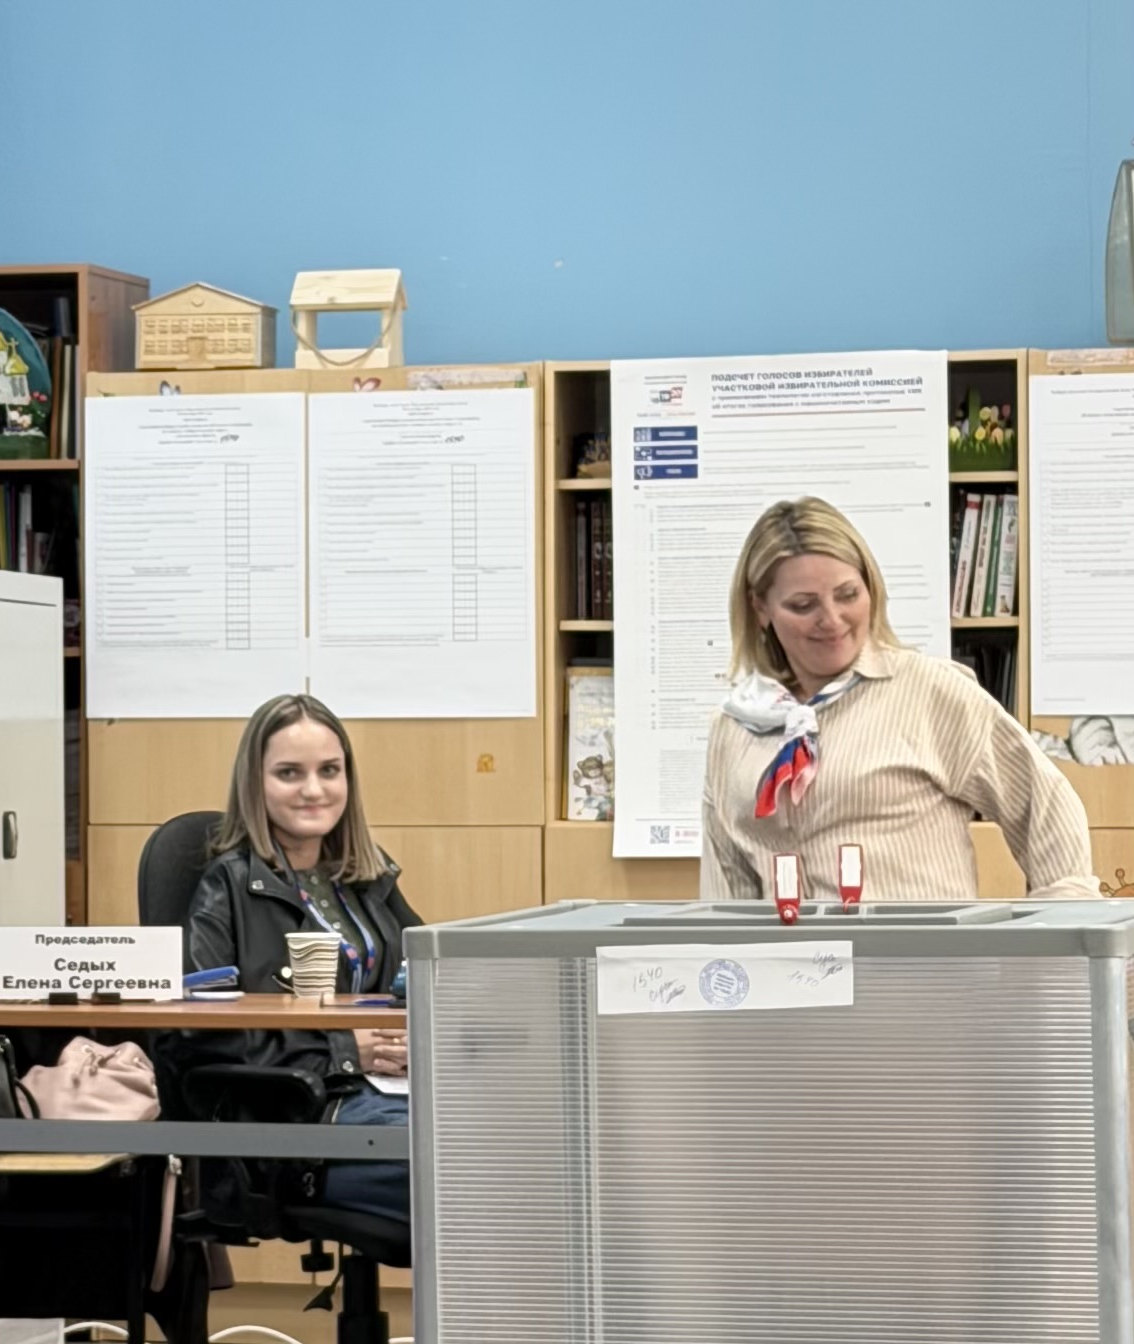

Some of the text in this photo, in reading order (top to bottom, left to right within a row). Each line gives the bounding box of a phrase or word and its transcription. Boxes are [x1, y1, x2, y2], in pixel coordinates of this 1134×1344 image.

[711, 367, 873, 382] ПОДСЧЕТ ГОЛОСОВ ИЗБИРАТЕЛЕЙ
[711, 382, 776, 392] УЧАСТКОВОЙ
[34, 934, 136, 946] Председатель
[53, 957, 117, 973] Седых
[2, 975, 172, 993] Елена Сергеевна
